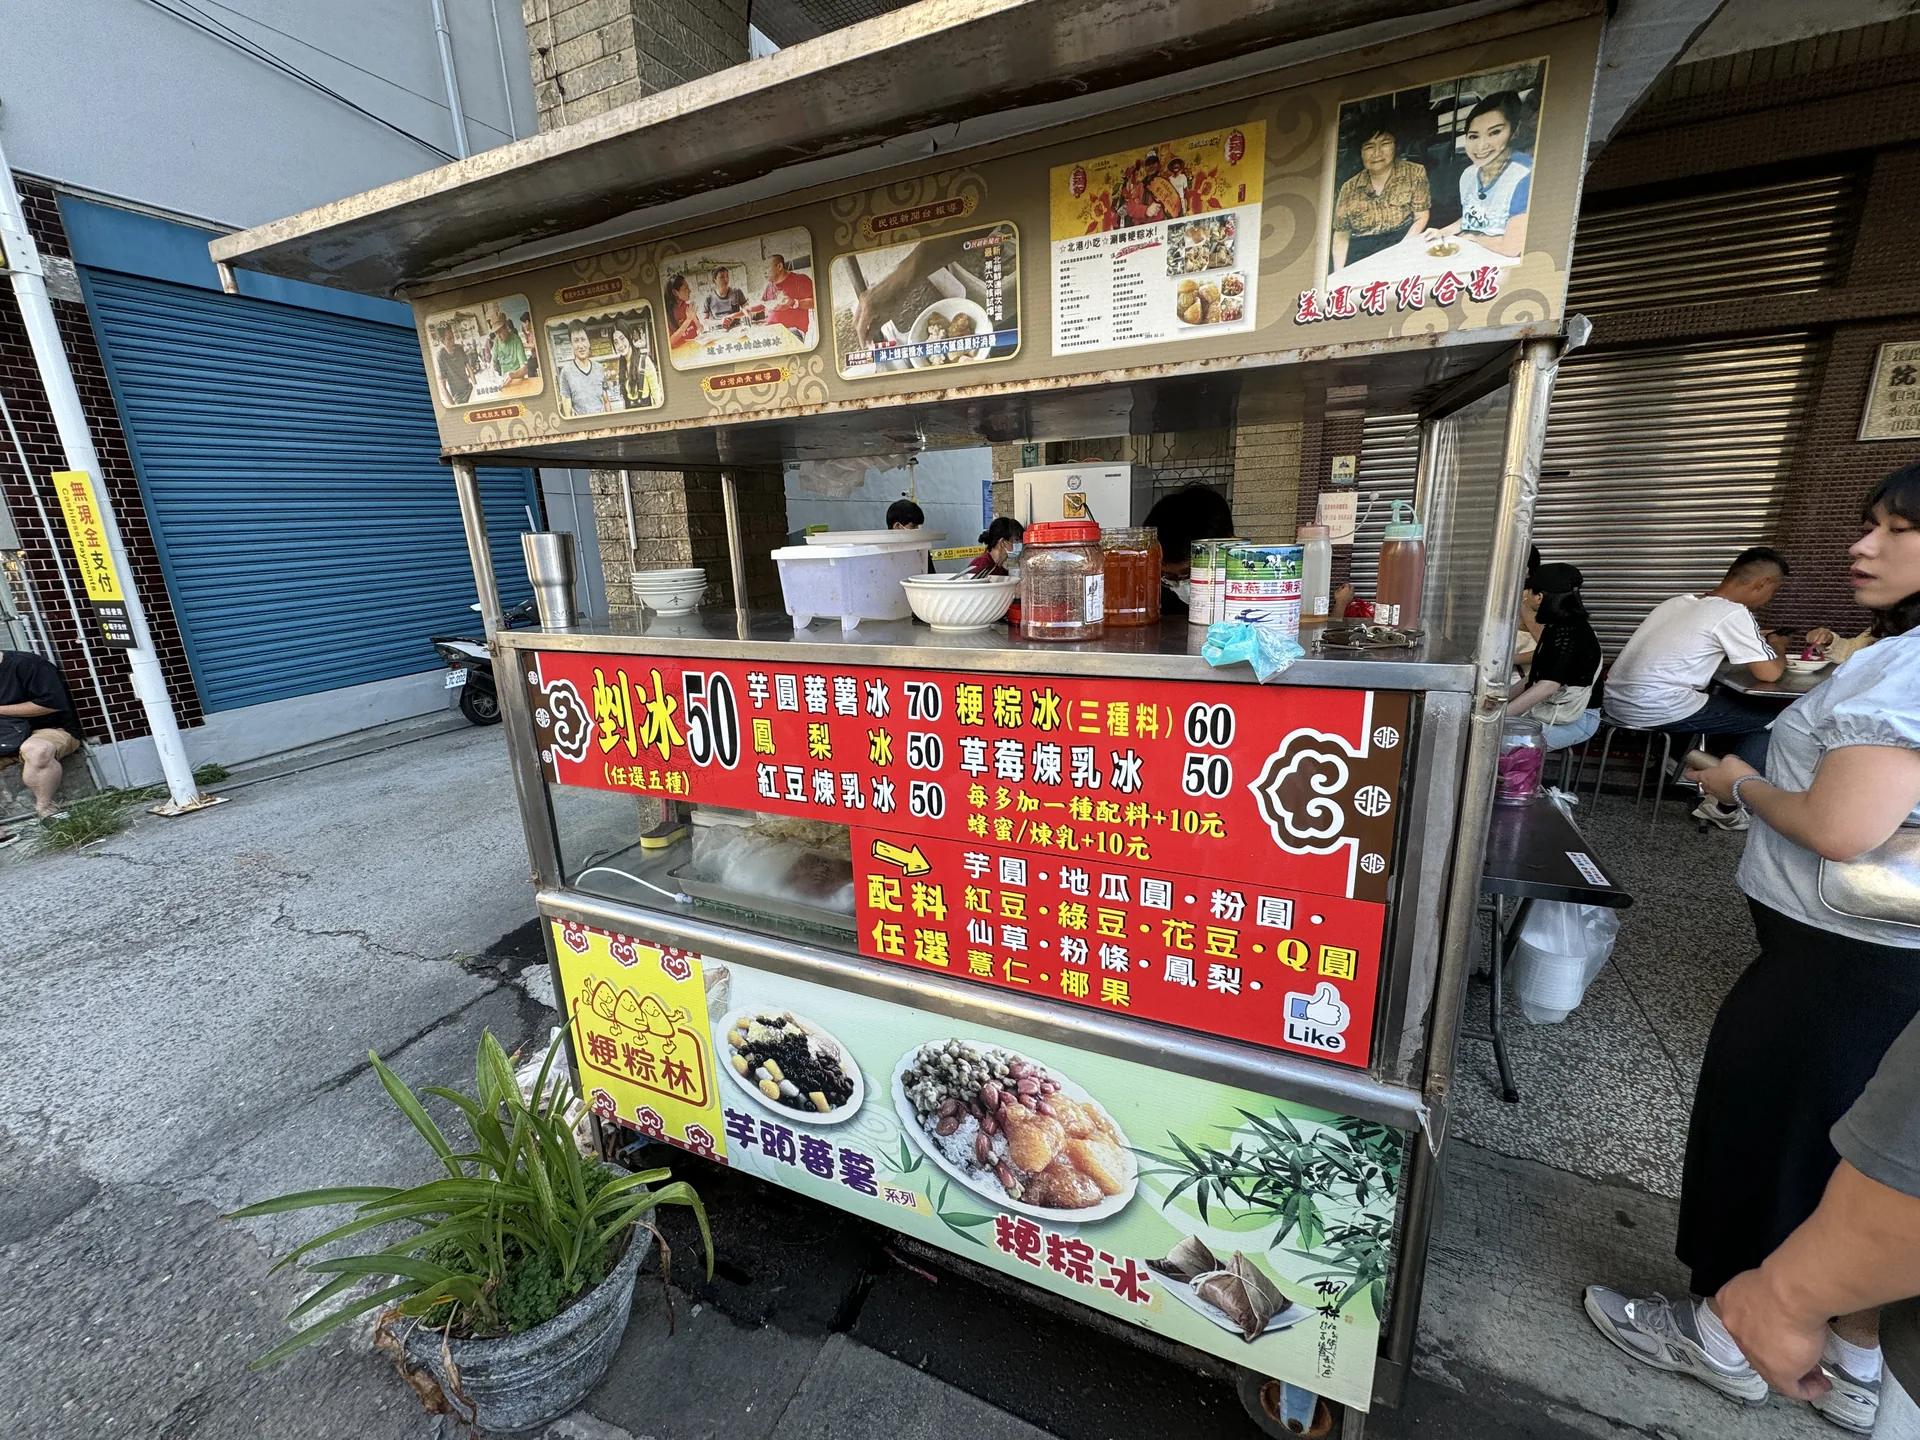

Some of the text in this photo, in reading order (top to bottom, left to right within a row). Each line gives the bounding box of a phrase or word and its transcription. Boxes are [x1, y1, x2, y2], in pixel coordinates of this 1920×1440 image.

[878, 203, 957, 228] 民視新聞台 報導
[1067, 237, 1101, 252] 北港小吃
[1294, 266, 1501, 324] 美鳳有約合影
[754, 372, 772, 381] 報導
[879, 347, 924, 361] 淋上蜂蜜糖水
[62, 487, 97, 592] Cashless Payments
[70, 481, 113, 593] 無現金支付
[1230, 581, 1260, 594] 飛燕
[682, 670, 741, 770] 50
[747, 671, 942, 722] 芋圓蕃薯冰 70
[752, 717, 944, 771] 鳳梨冰 50
[1184, 702, 1235, 749] 60
[604, 761, 691, 796] (任選五種)
[756, 762, 946, 820] 紅豆煉乳冰 50
[958, 736, 1233, 799] 草莓煉乳冰 50
[966, 782, 1227, 839] 每多加一種配料+10元
[967, 813, 1151, 861] 蜂蜜/煉乳+10元
[867, 873, 948, 921] 配料
[871, 919, 950, 967] 任選
[1288, 1023, 1341, 1049] Like
[724, 1108, 917, 1209] 芋頭蕃薯 系列
